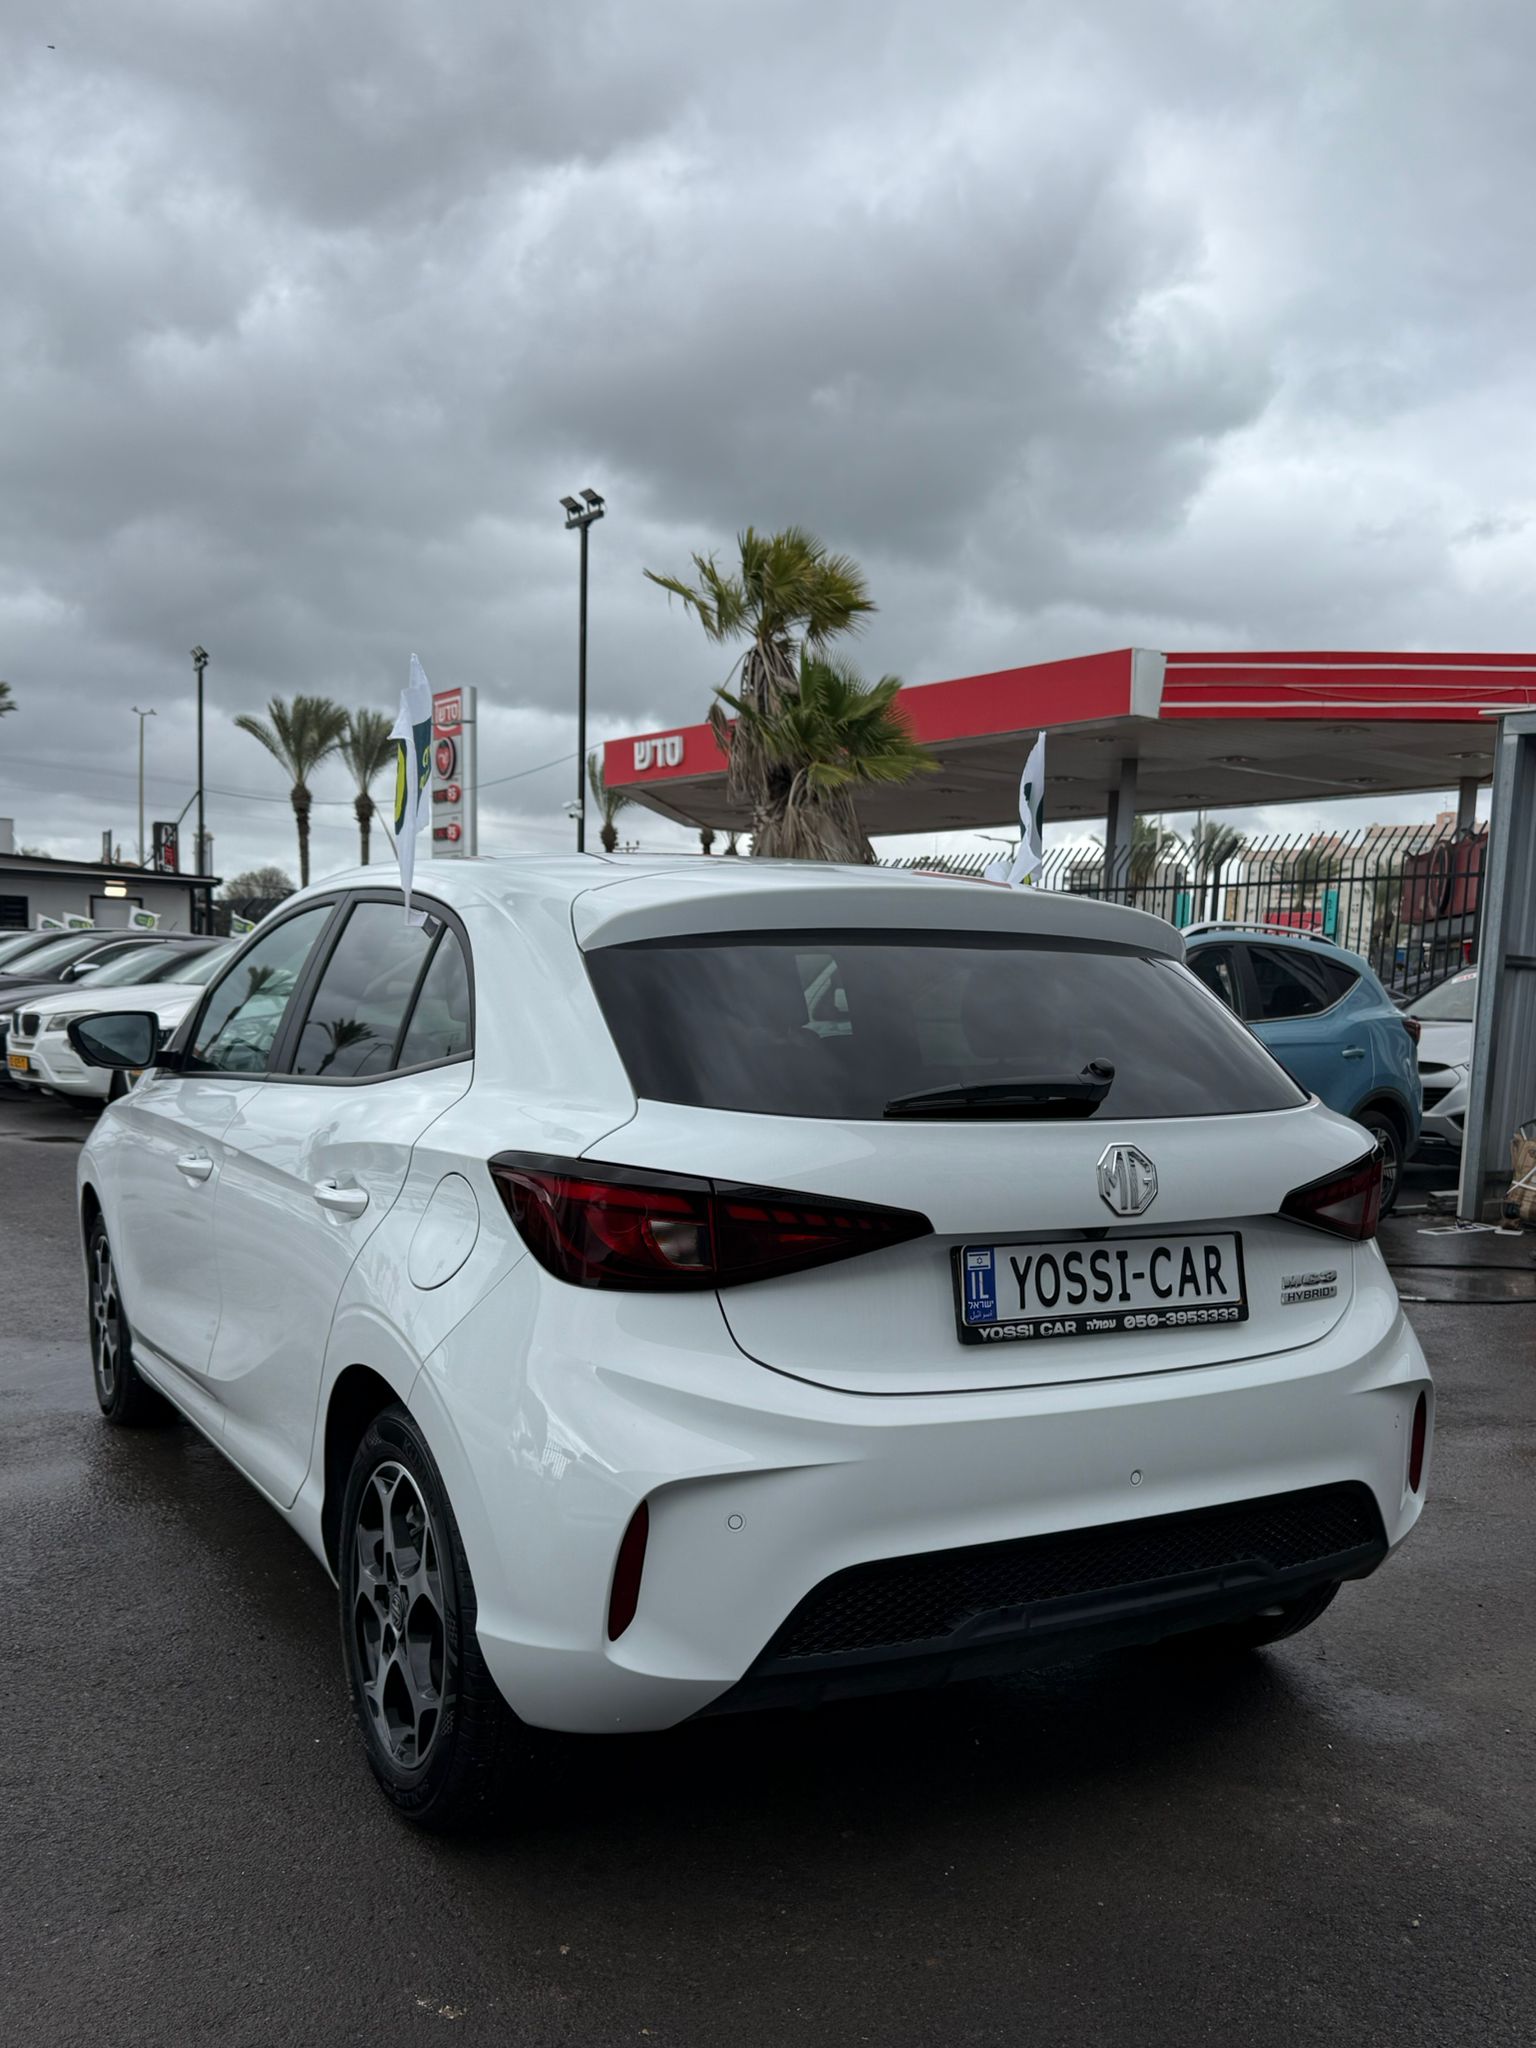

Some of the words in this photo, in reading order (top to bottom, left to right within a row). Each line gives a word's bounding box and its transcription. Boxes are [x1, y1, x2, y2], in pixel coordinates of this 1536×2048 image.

[633, 736, 684, 771] סדש
[1101, 1147, 1154, 1213] MG
[971, 1271, 989, 1300] IL
[1010, 1245, 1228, 1310] YOSSI-CAR
[968, 1300, 994, 1309] ישראל
[978, 1323, 1034, 1341] YOSSI
[1040, 1321, 1077, 1337] CAR
[1086, 1318, 1117, 1331] עפולה
[1123, 1307, 1239, 1329] 050-3953333
